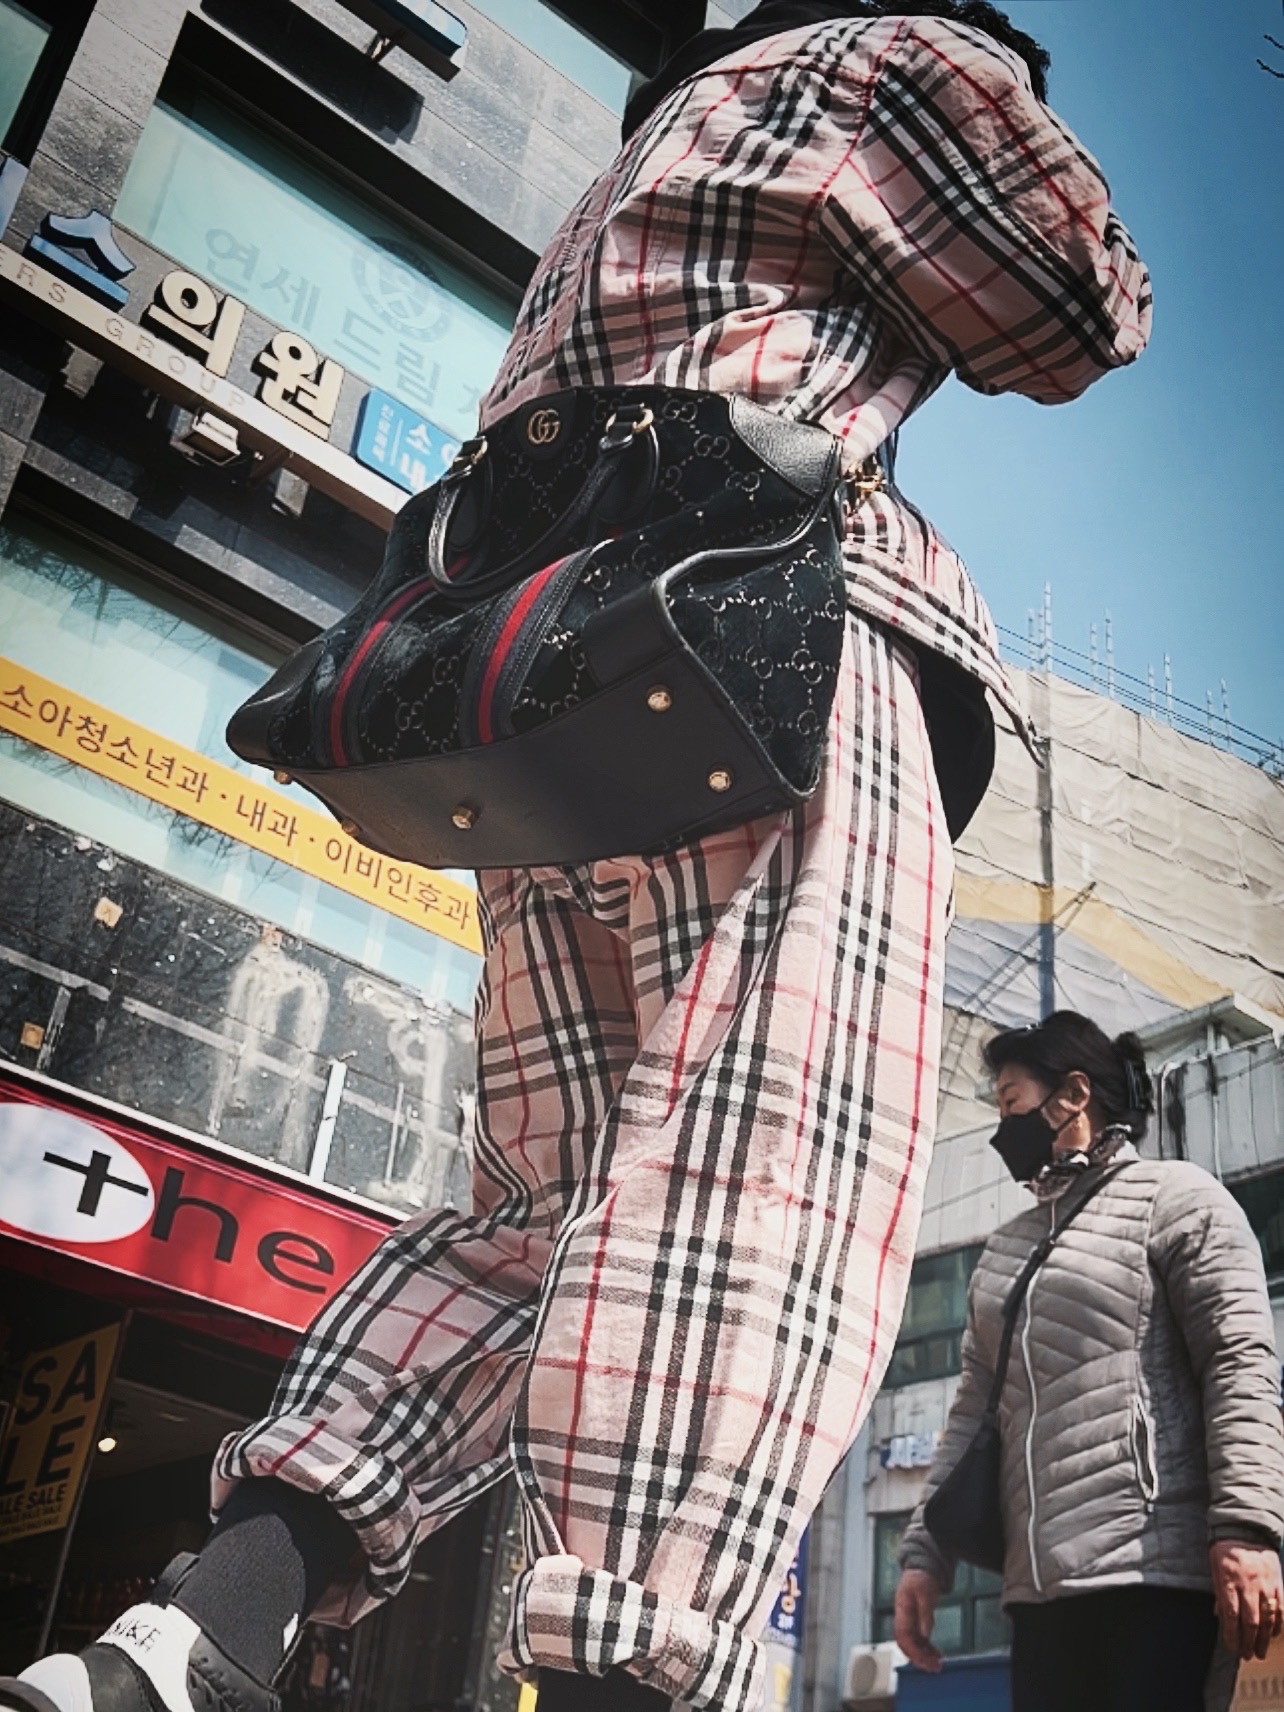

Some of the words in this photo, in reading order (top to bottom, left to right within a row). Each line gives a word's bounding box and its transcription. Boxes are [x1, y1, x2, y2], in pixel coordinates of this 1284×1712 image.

[0, 248, 68, 304] RS
[106, 317, 247, 411] GROUP
[0, 684, 209, 803] 소아청소년과
[237, 793, 299, 848] 내과
[325, 837, 472, 931] 이비인후과
